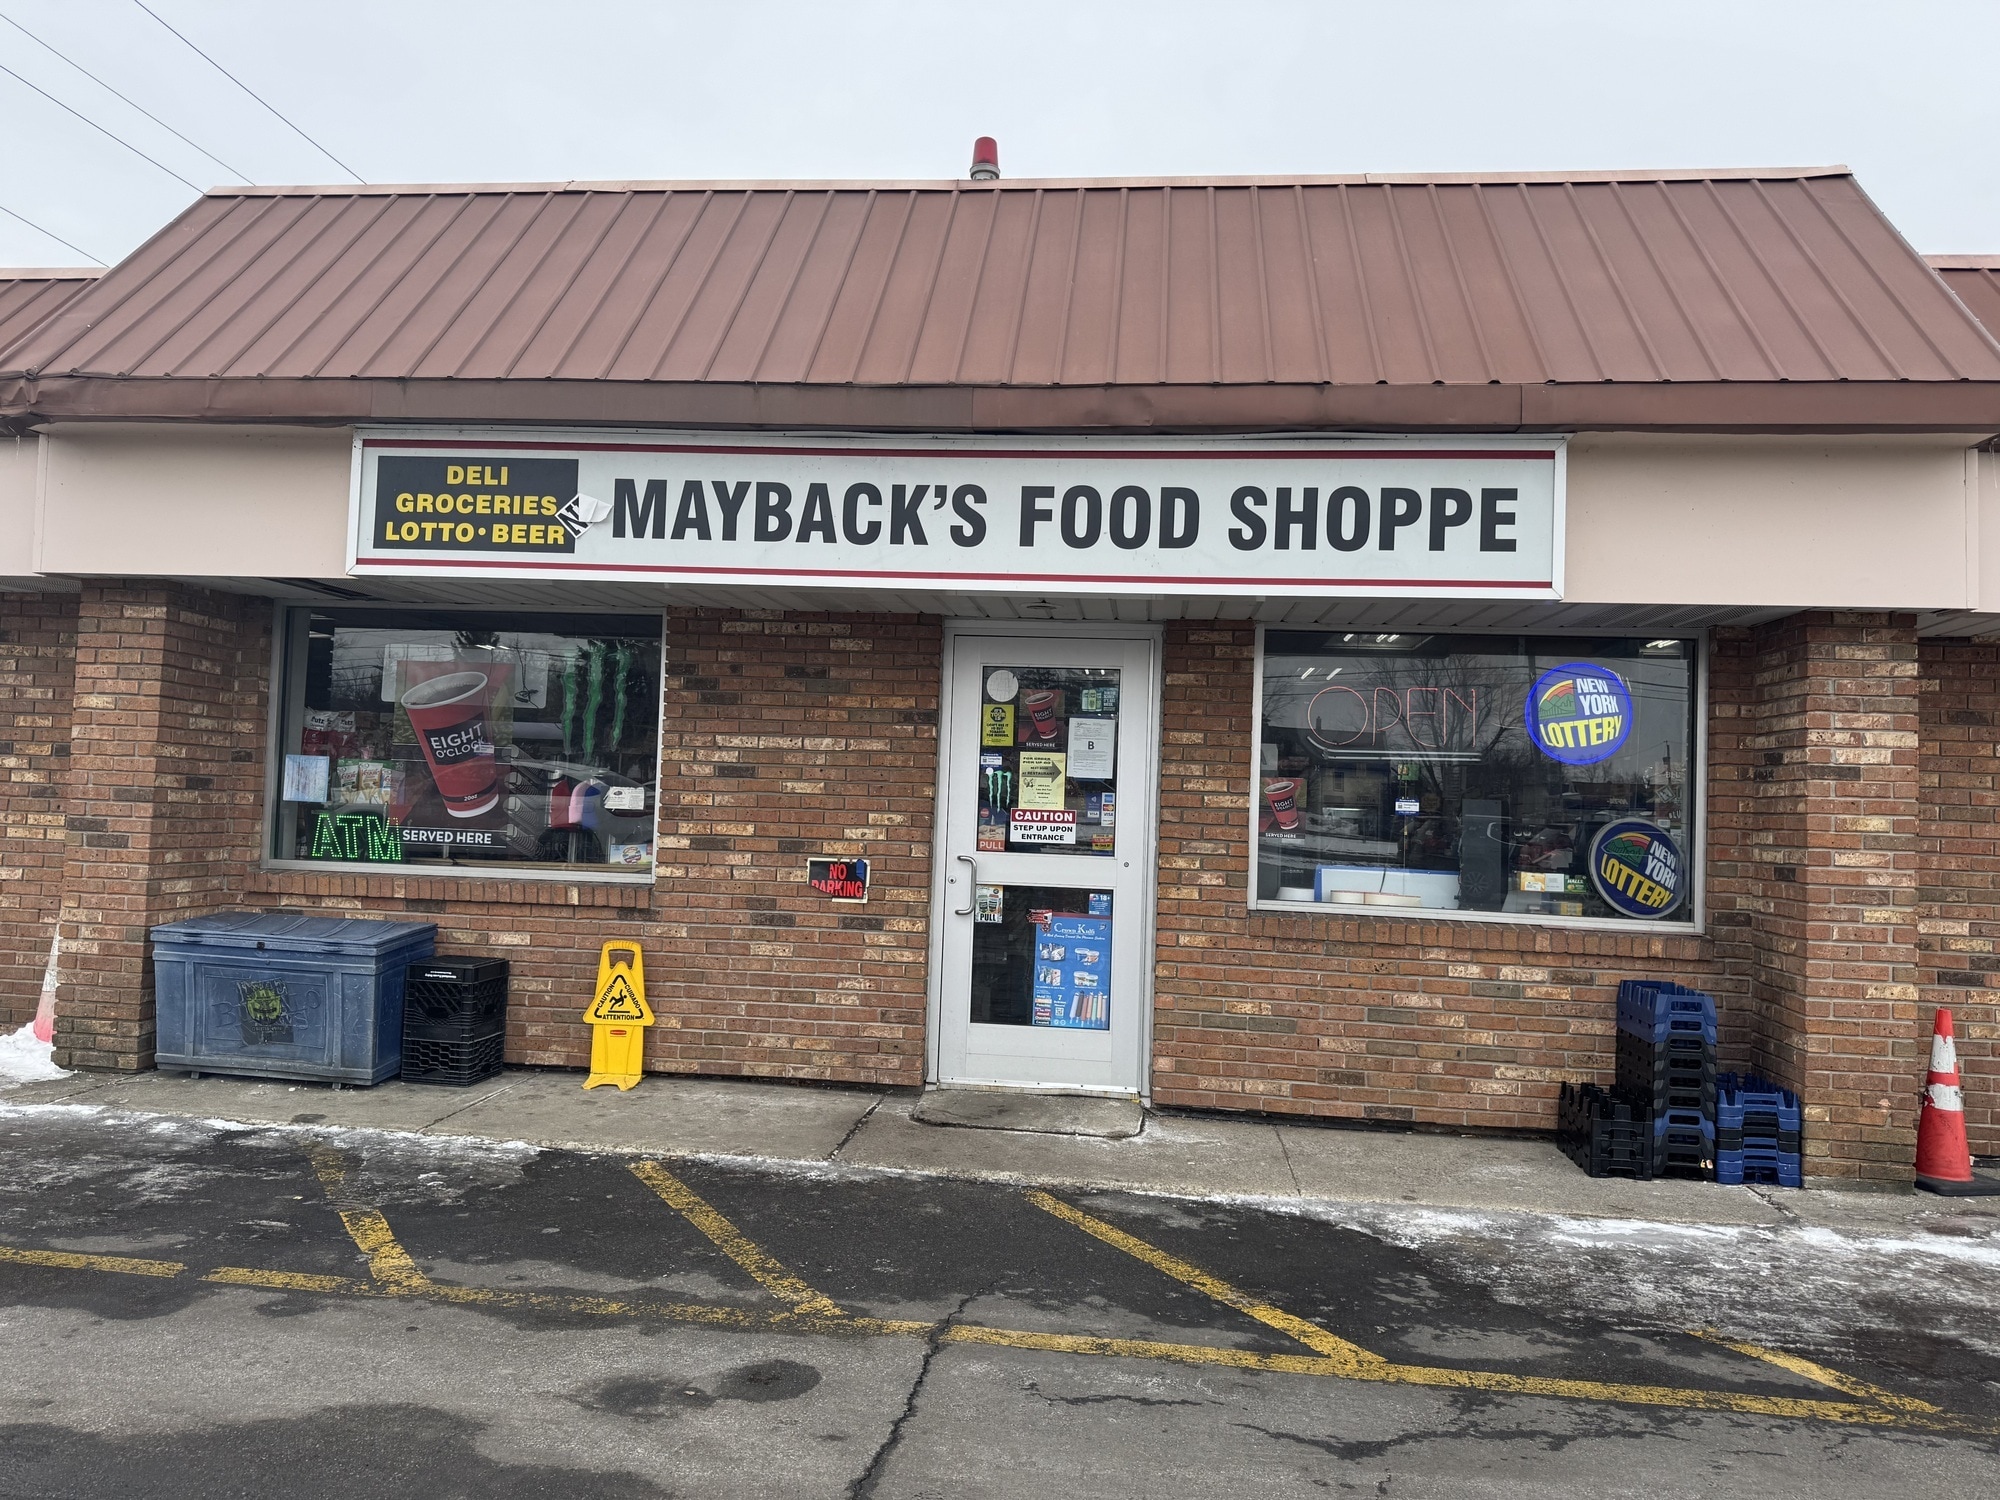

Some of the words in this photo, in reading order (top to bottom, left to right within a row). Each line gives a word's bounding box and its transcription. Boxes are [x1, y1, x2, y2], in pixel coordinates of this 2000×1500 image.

[447, 465, 508, 485] DELI
[395, 493, 557, 516] GROCERIES
[613, 478, 986, 548] MAYBACK'S
[1019, 485, 1200, 549] FOOD
[1228, 485, 1518, 552] SHOPPE
[1576, 678, 1609, 693] NEW
[1579, 694, 1619, 716] YORK
[1307, 685, 1476, 748] OPEN
[430, 722, 482, 749] EIGHT
[1539, 715, 1622, 748] LOTTERY
[436, 737, 487, 758] O'CLOCK
[1087, 741, 1095, 750] B
[1014, 811, 1073, 822] CAUTION
[312, 815, 401, 860] ATM
[402, 829, 453, 843] SERVED
[456, 832, 492, 844] HERE
[980, 841, 1004, 850] PULL
[1021, 833, 1064, 841] ENTRANCE
[1649, 840, 1676, 870] NEW
[829, 863, 847, 880] NO
[1601, 853, 1674, 909] LOTTERY
[1645, 854, 1677, 890] YORK
[980, 913, 996, 921] PULL
[597, 984, 615, 1008] CAUTION
[624, 984, 641, 1009] CUIDADO
